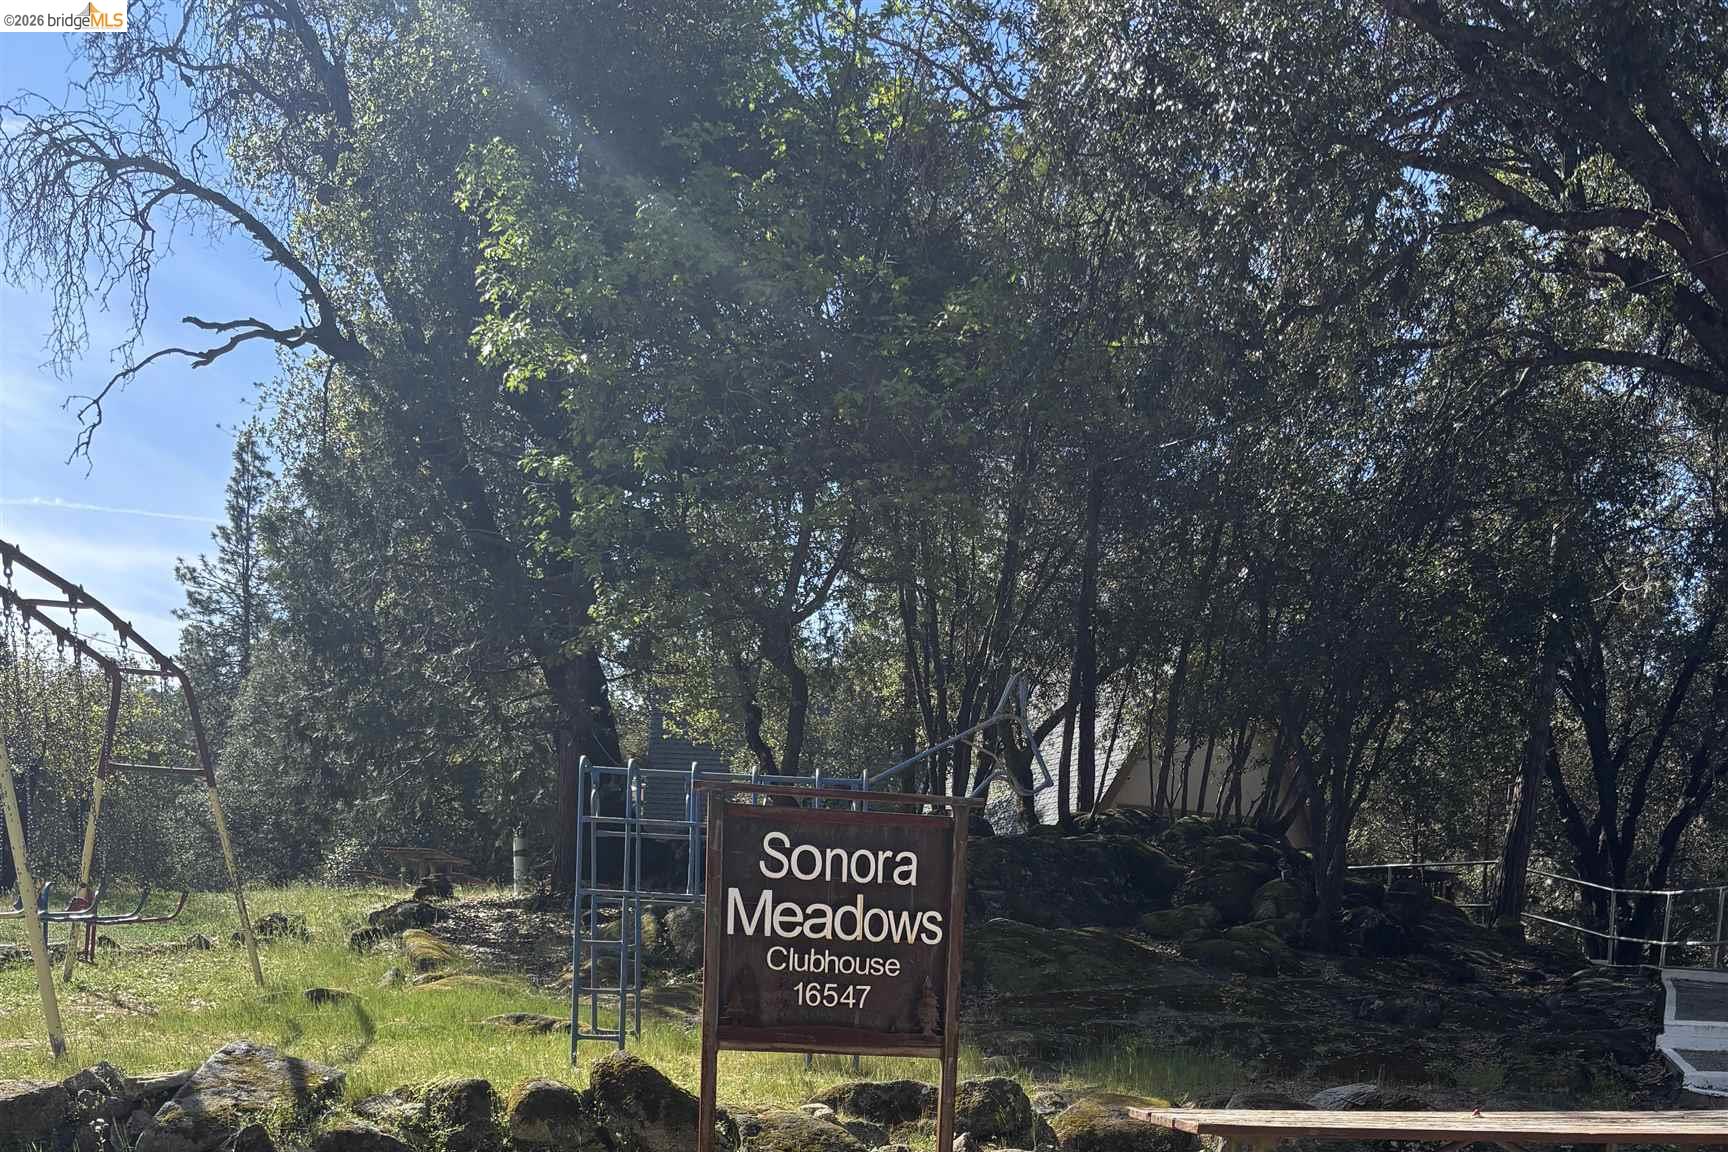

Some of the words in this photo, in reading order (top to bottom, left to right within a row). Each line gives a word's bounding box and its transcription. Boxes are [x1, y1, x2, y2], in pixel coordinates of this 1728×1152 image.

[758, 831, 918, 887] Sonora
[726, 887, 943, 945] Meadows
[766, 946, 902, 977] Clubhouse
[793, 982, 872, 1009] 16547
